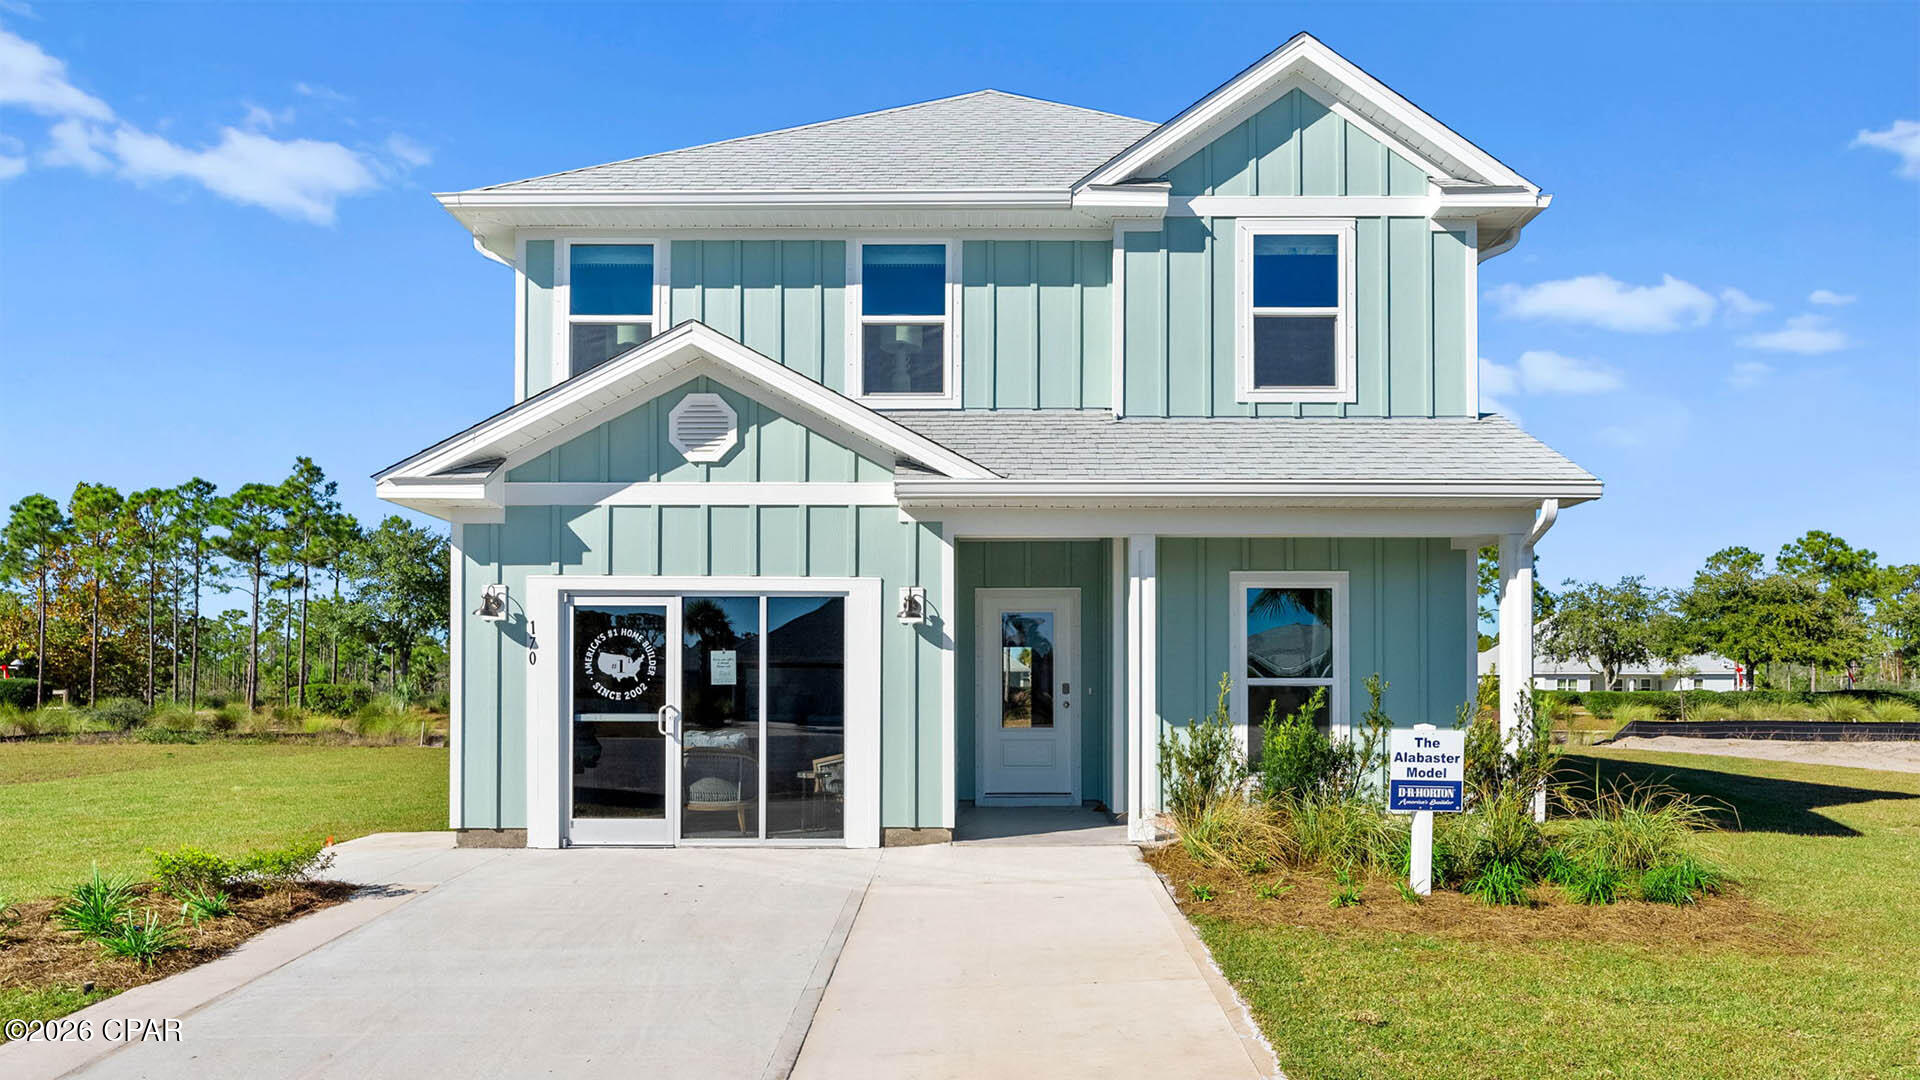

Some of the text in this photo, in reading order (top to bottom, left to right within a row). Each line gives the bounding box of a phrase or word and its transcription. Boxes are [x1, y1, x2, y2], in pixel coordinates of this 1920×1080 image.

[584, 627, 657, 677] AMERICA'S #1 HOME BUILDER
[592, 682, 648, 701] SINCE 2002
[1414, 737, 1441, 748] The
[1394, 751, 1461, 763] Alabaster
[1406, 767, 1447, 778] Model
